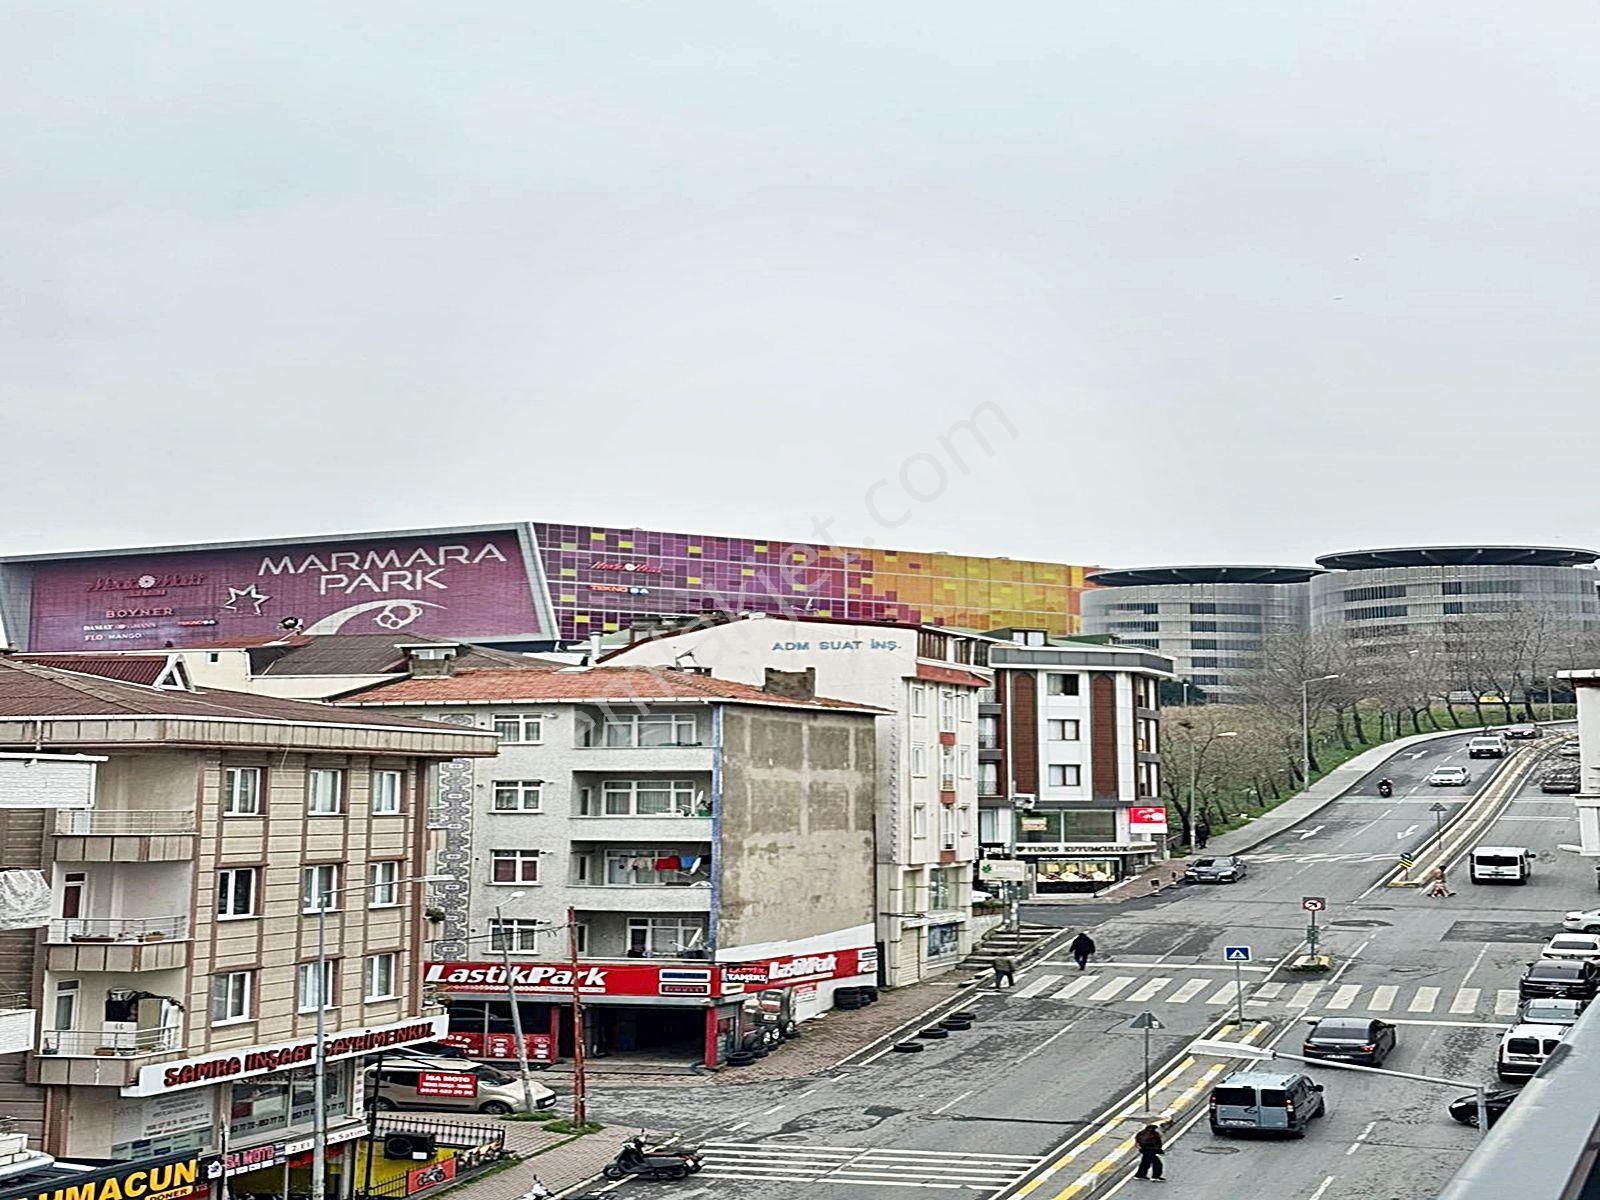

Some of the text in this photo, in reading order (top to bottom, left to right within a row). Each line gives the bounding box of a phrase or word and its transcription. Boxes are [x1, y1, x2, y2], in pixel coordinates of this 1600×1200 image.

[258, 543, 507, 575] MARMARA
[319, 568, 448, 595] PARK
[105, 607, 174, 619] BOYNER
[772, 642, 810, 651] ADM
[818, 640, 863, 651] SUAT
[425, 965, 608, 986] LastikPark
[164, 1056, 241, 1087] SAMRA
